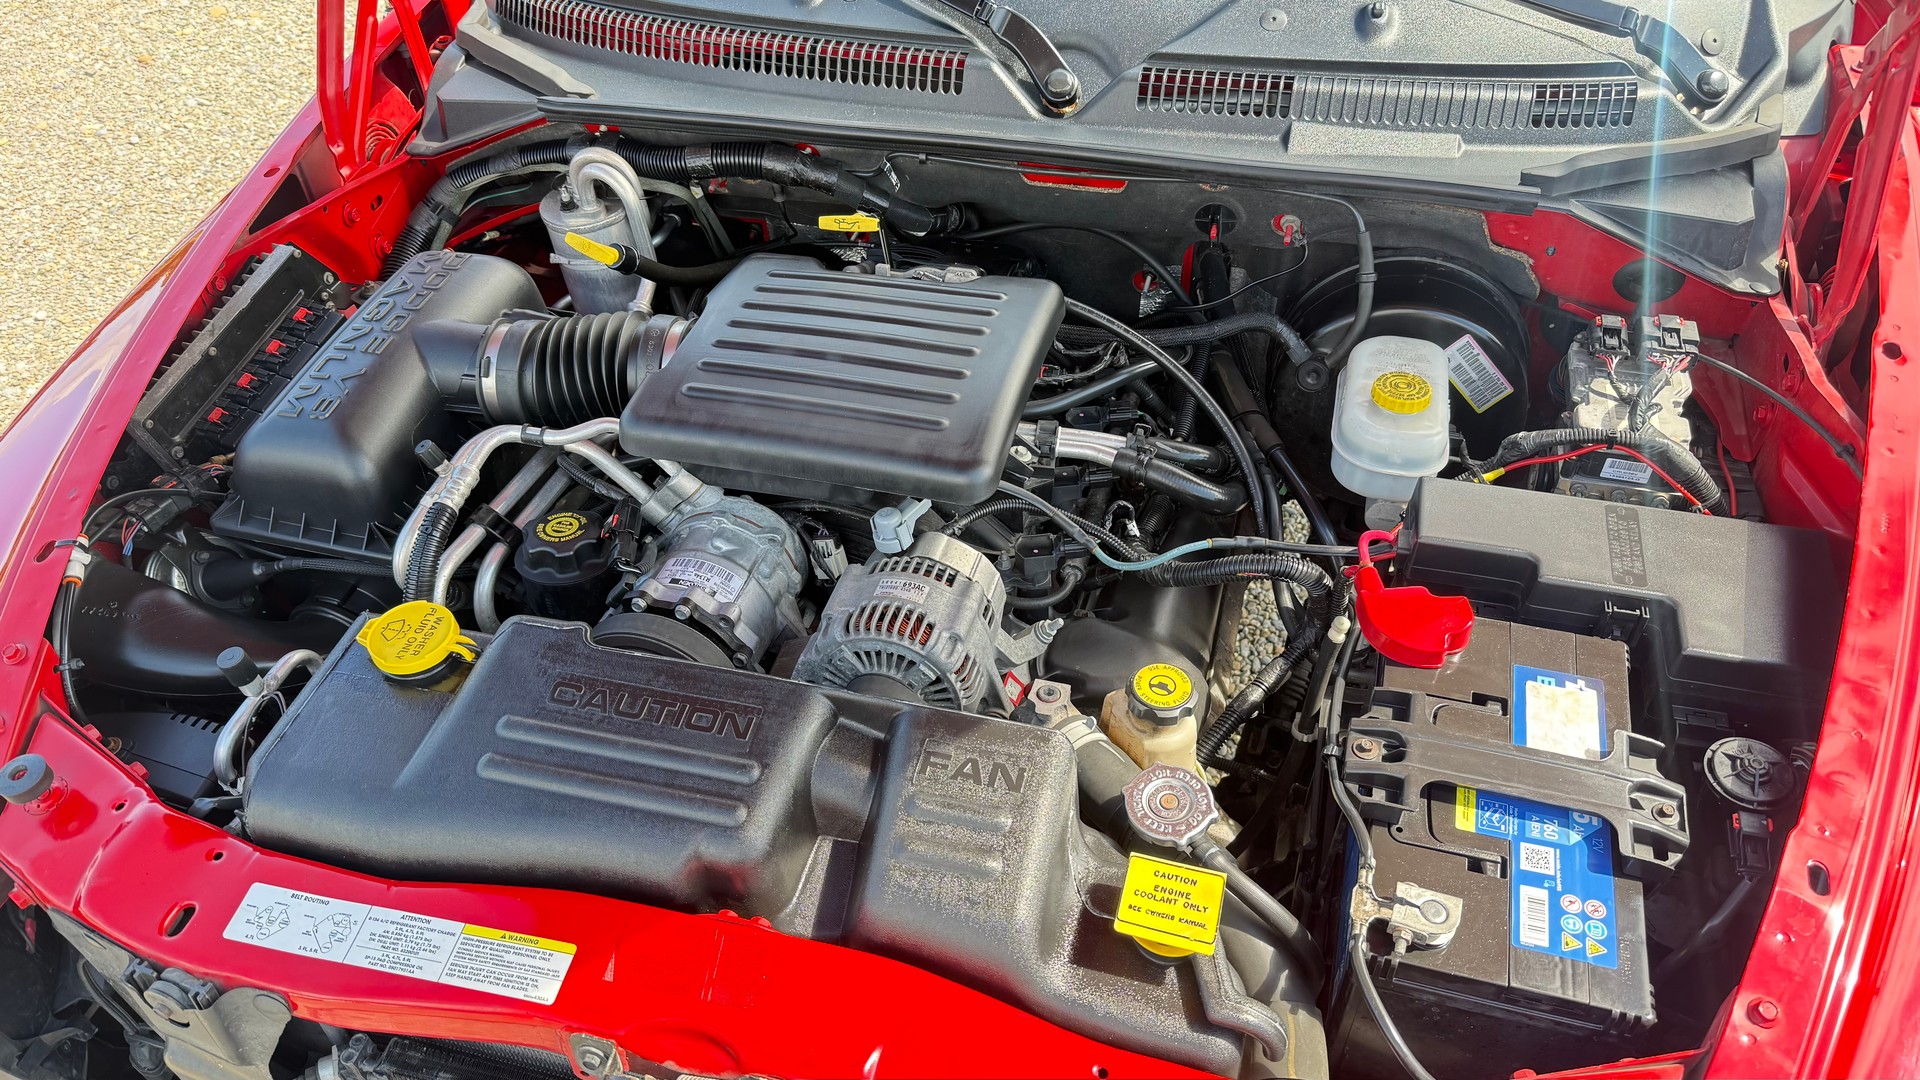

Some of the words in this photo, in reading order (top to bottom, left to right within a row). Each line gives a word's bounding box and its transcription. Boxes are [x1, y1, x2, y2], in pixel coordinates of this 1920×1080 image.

[360, 252, 473, 355] DODGE
[276, 250, 446, 418] MAGNUM
[307, 367, 368, 420] V8
[902, 581, 926, 592] 693AC
[414, 607, 437, 634] FLUID
[410, 616, 445, 657] WASHER
[395, 636, 417, 660] ONLY
[1162, 665, 1189, 684] APPROVED
[1135, 675, 1143, 691] POWER
[1141, 693, 1170, 706] STEERING
[1174, 691, 1189, 704] FLUID
[547, 679, 758, 742] CAUTION
[916, 750, 1029, 795] FAN
[1150, 769, 1172, 781] HOT
[1175, 771, 1201, 790] OPEN
[1197, 793, 1208, 811] NOT
[1143, 819, 1172, 833] KEEP
[1188, 813, 1203, 826] DO
[1542, 819, 1558, 839] 760
[1572, 824, 1584, 837] Ah
[1591, 837, 1604, 853] 12V
[1153, 870, 1198, 886] CAUTION
[1153, 884, 1192, 900] ENGINE
[303, 896, 330, 905] ROUTING
[1133, 889, 1178, 906] COOLANT
[1183, 901, 1209, 914] ONLY
[400, 914, 431, 924] ATTENTION
[1128, 904, 1142, 912] SEE
[1145, 909, 1175, 921] OWNERS
[389, 920, 416, 929] REFRIGERANT
[496, 943, 524, 951] REFRIGERANT
[508, 934, 539, 945] WARNING
[489, 946, 511, 954] QUALIFIED
[512, 951, 537, 959] PERSONNEL
[386, 959, 415, 968] COMPRESSOR
